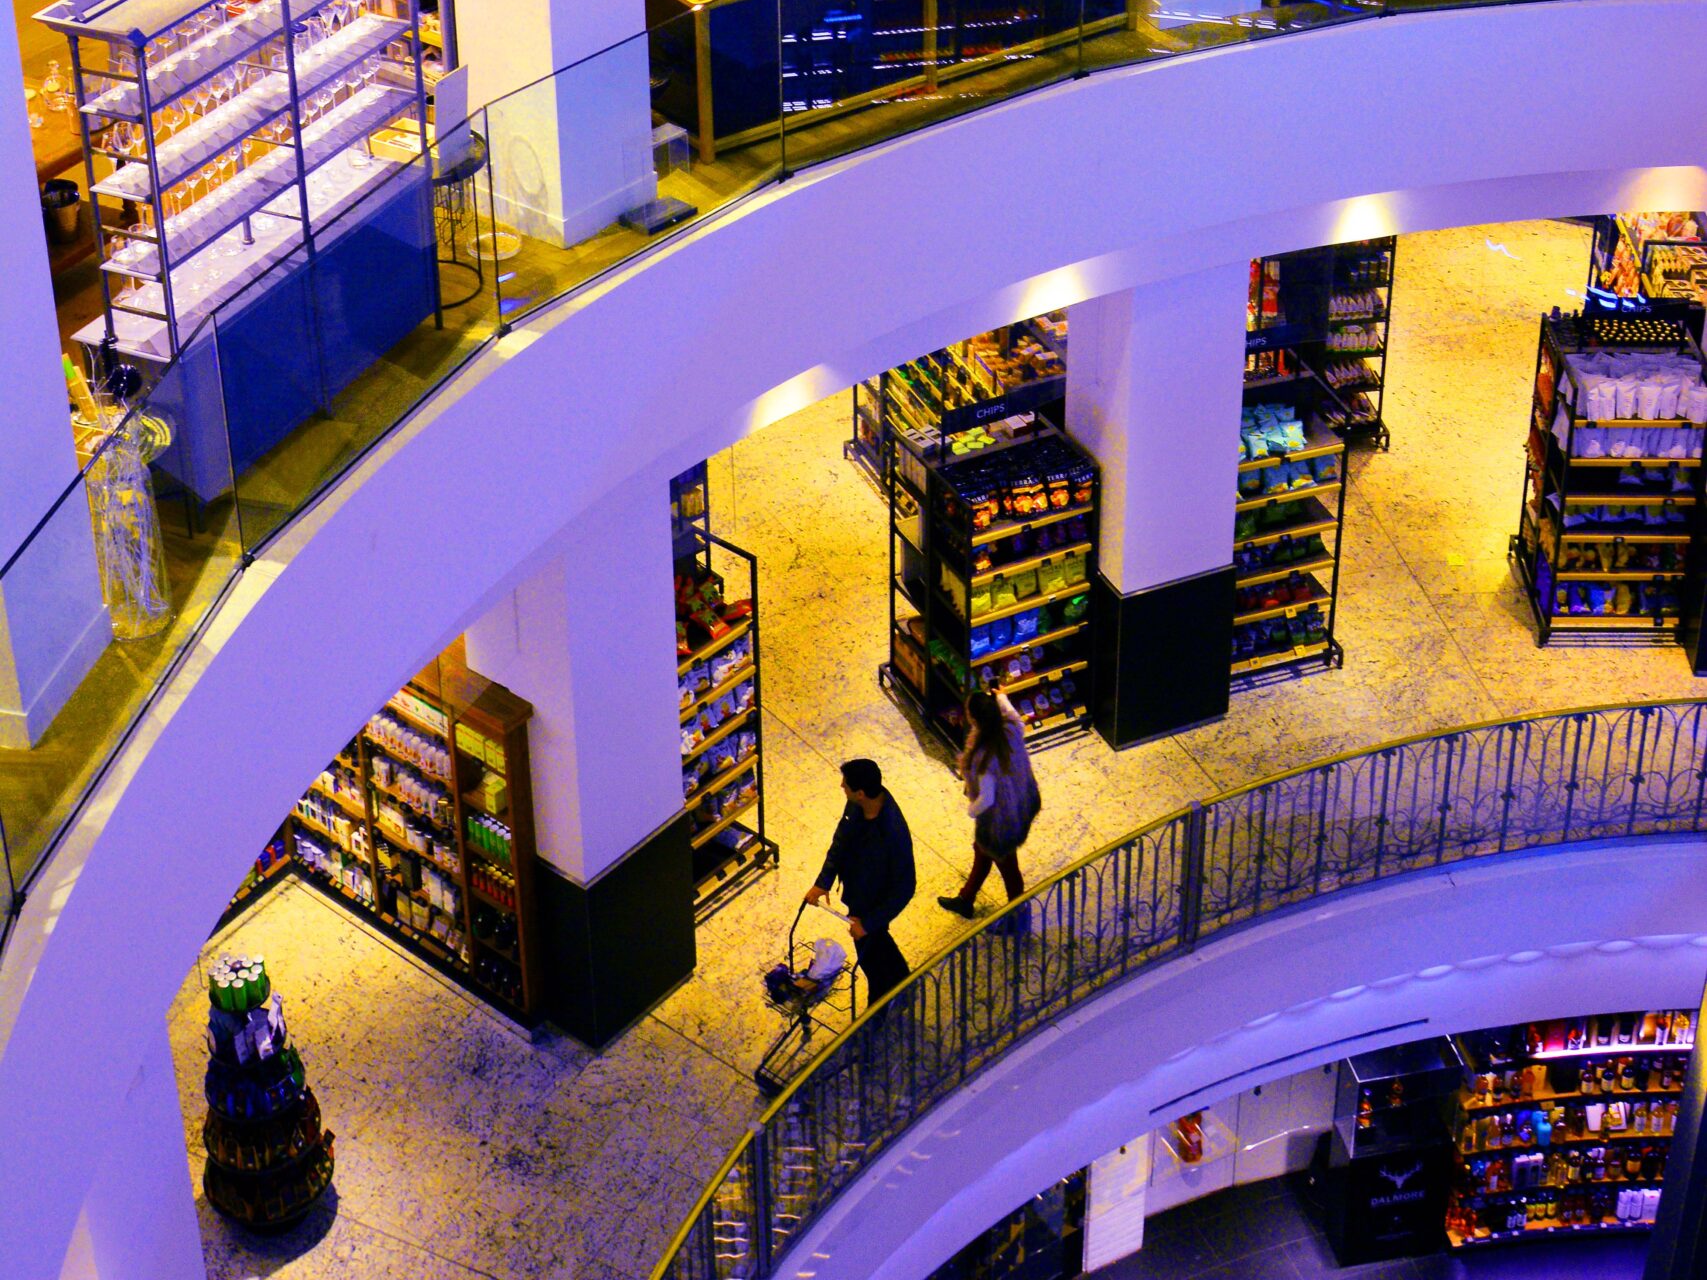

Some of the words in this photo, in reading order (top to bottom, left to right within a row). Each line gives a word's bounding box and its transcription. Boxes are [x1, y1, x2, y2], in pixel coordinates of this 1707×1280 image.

[1246, 336, 1267, 348] HIPS
[976, 403, 1006, 419] CHIPS
[1370, 1190, 1425, 1208] DALMORE
